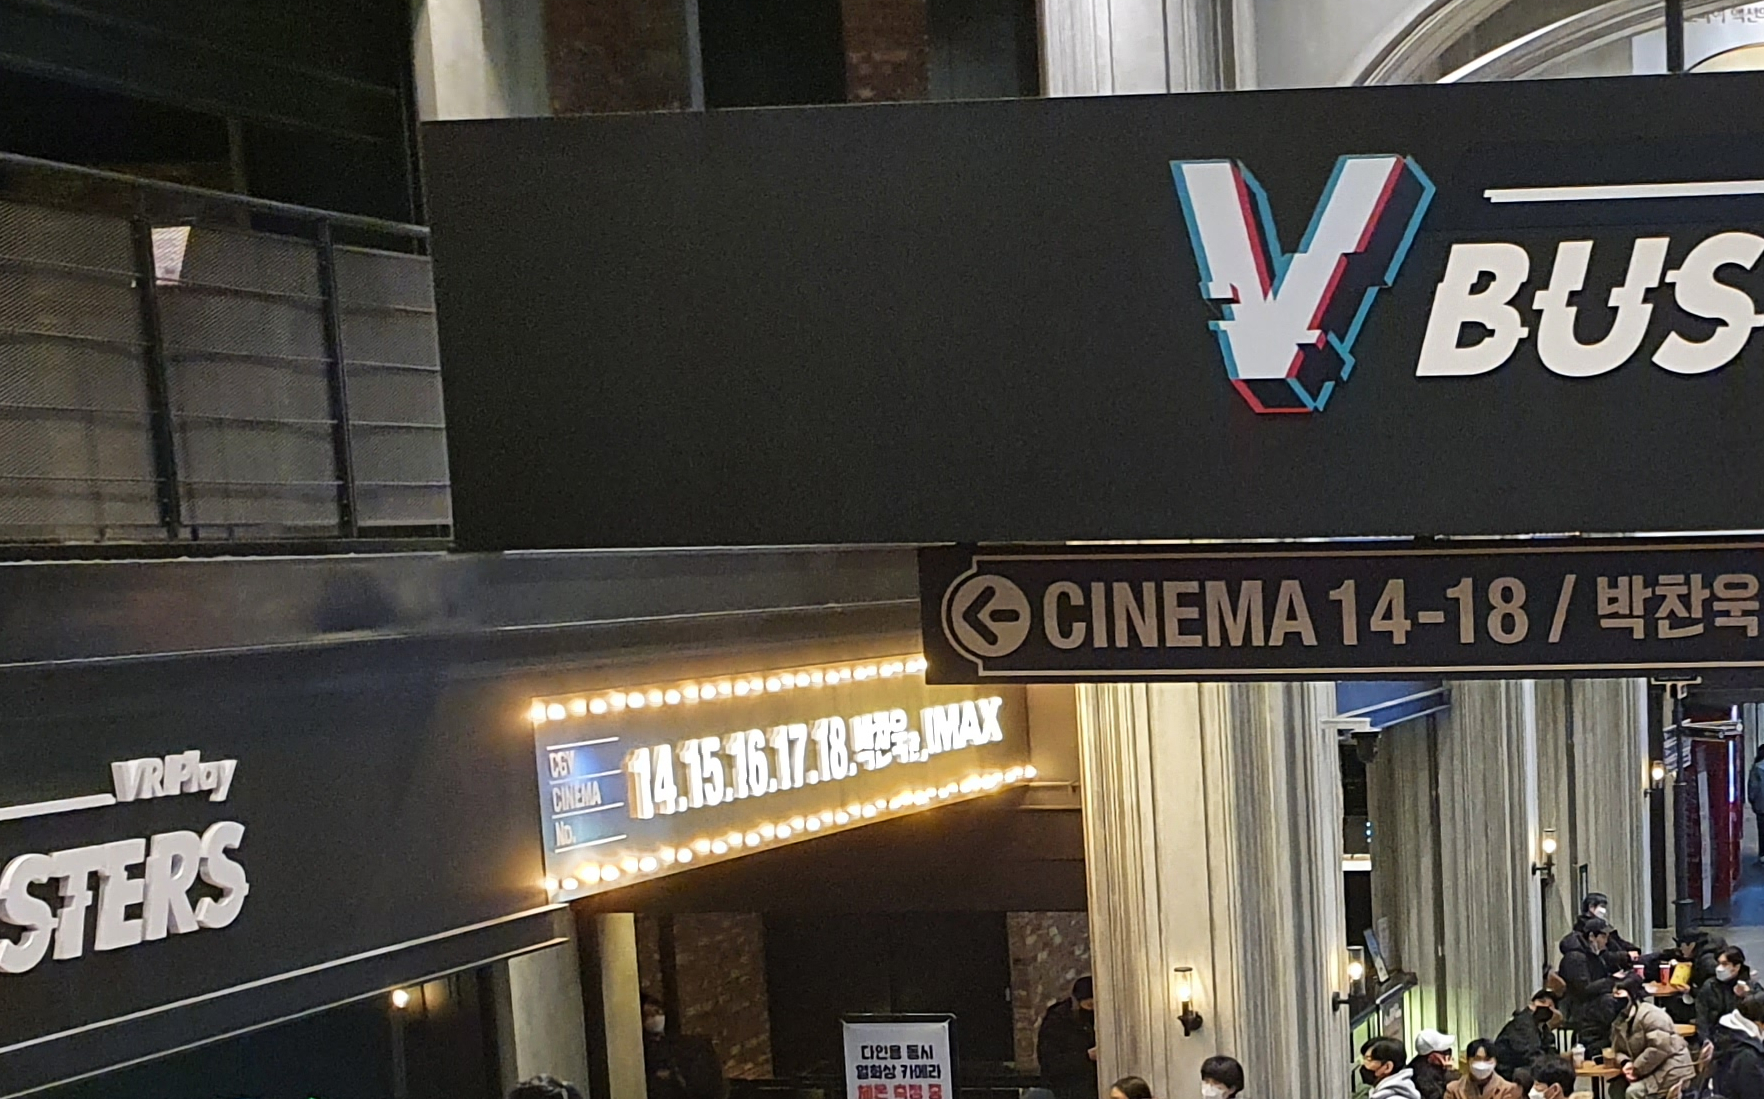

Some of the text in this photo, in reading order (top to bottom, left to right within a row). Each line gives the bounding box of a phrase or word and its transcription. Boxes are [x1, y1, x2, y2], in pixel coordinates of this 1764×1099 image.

[1042, 578, 1319, 650] CINEMA
[1328, 576, 1530, 646] 14-18
[111, 749, 239, 803] VR Play
[548, 749, 576, 778] CGV
[551, 780, 603, 813] CINEMA
[901, 1064, 942, 1080] 카메라
